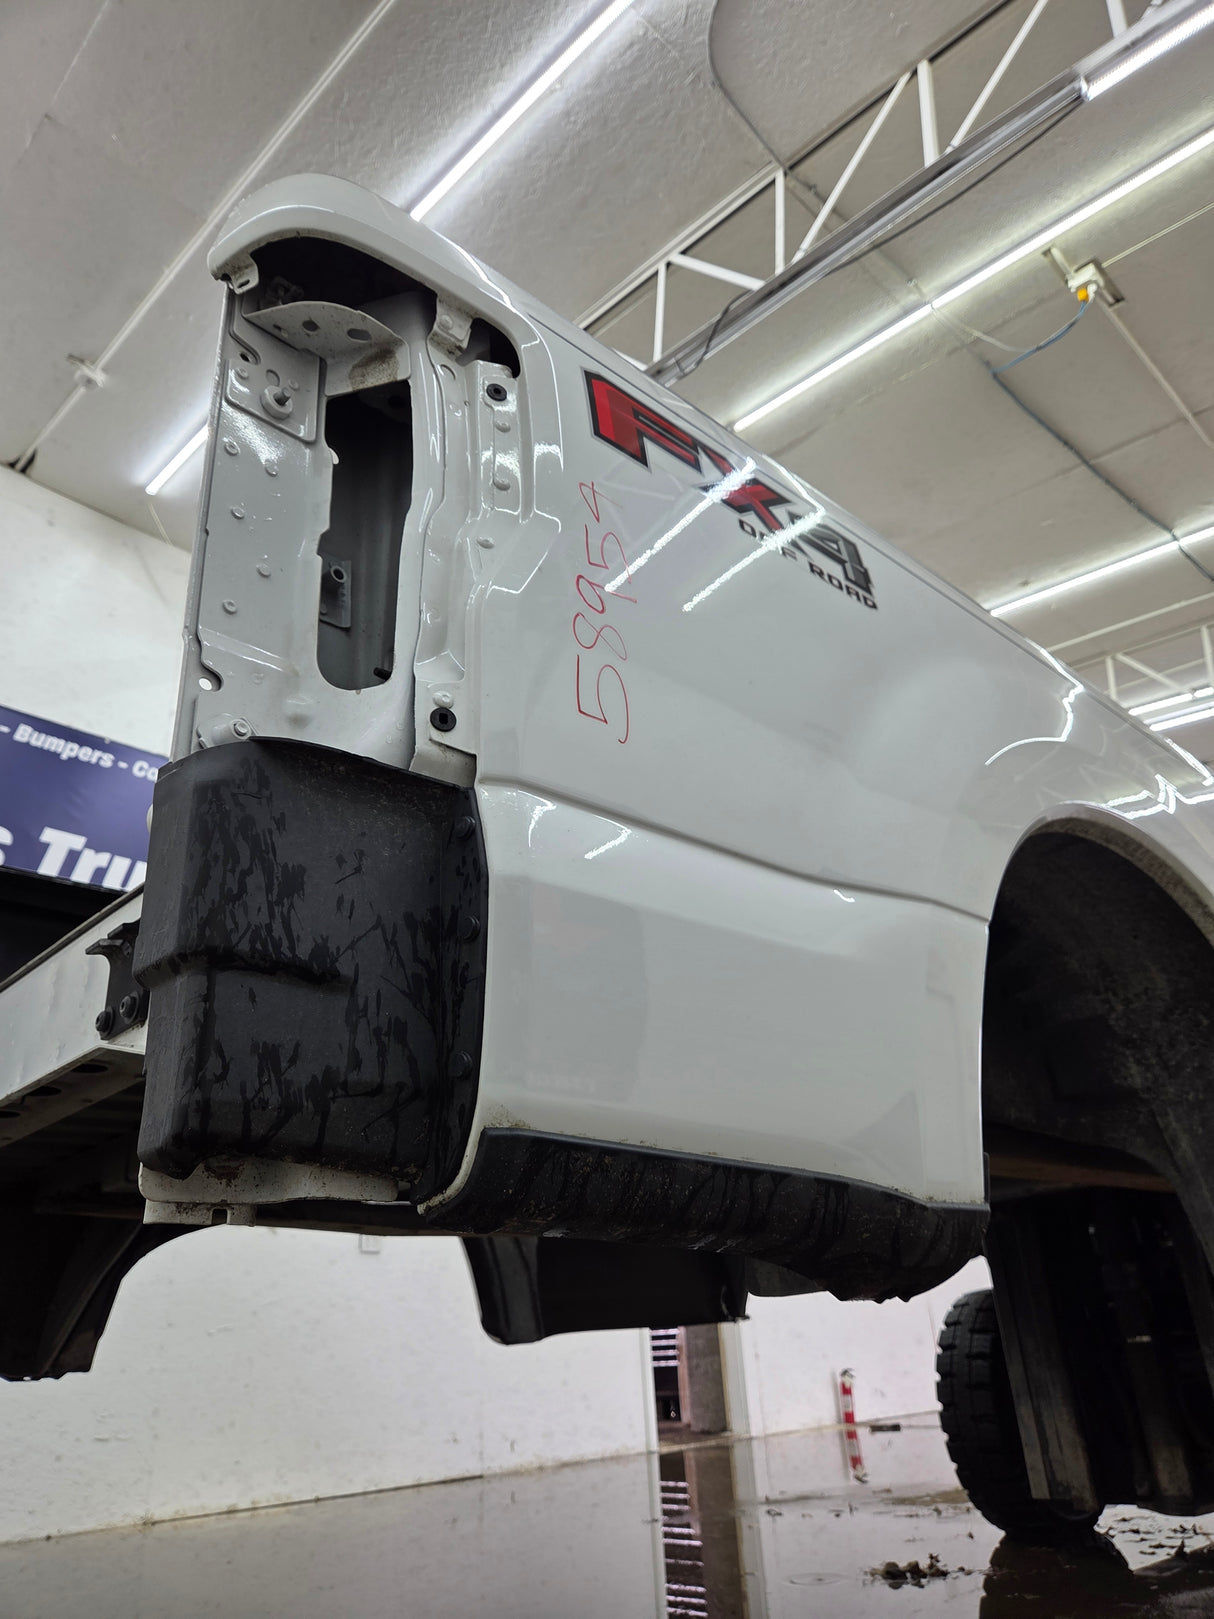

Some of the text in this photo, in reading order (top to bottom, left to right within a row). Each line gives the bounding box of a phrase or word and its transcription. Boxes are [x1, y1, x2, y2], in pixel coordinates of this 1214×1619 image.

[582, 368, 873, 597] FX4
[573, 481, 638, 744] 58954
[738, 518, 878, 610] OF ROAD
[13, 722, 116, 769] Bumpers
